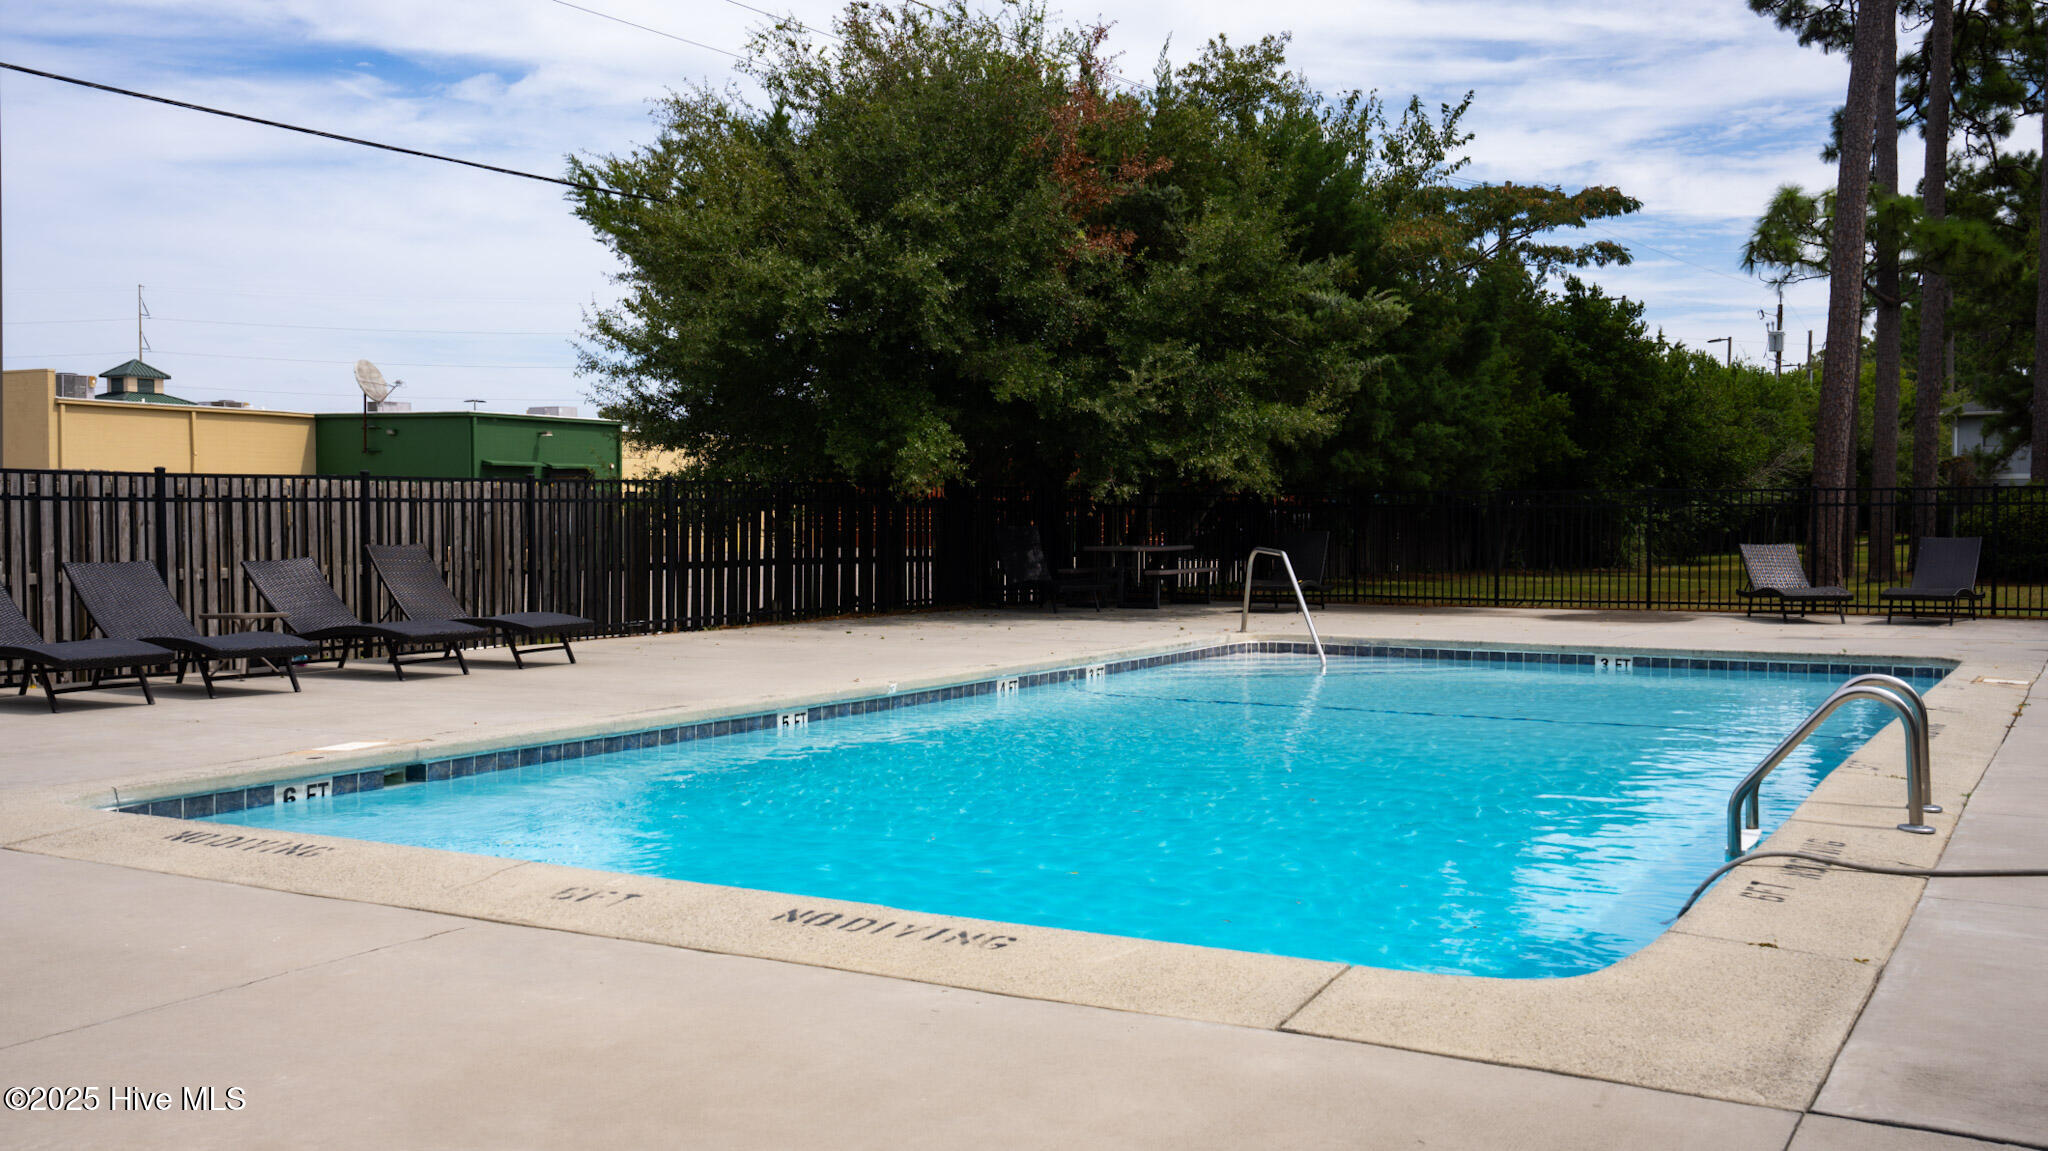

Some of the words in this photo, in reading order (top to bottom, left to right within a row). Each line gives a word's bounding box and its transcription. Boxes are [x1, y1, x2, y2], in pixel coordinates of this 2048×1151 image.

[1600, 658, 1609, 671] 3
[1615, 658, 1631, 673] FT
[782, 715, 789, 727] 5
[795, 712, 807, 726] FT
[283, 786, 297, 803] 6
[306, 781, 329, 800] FT
